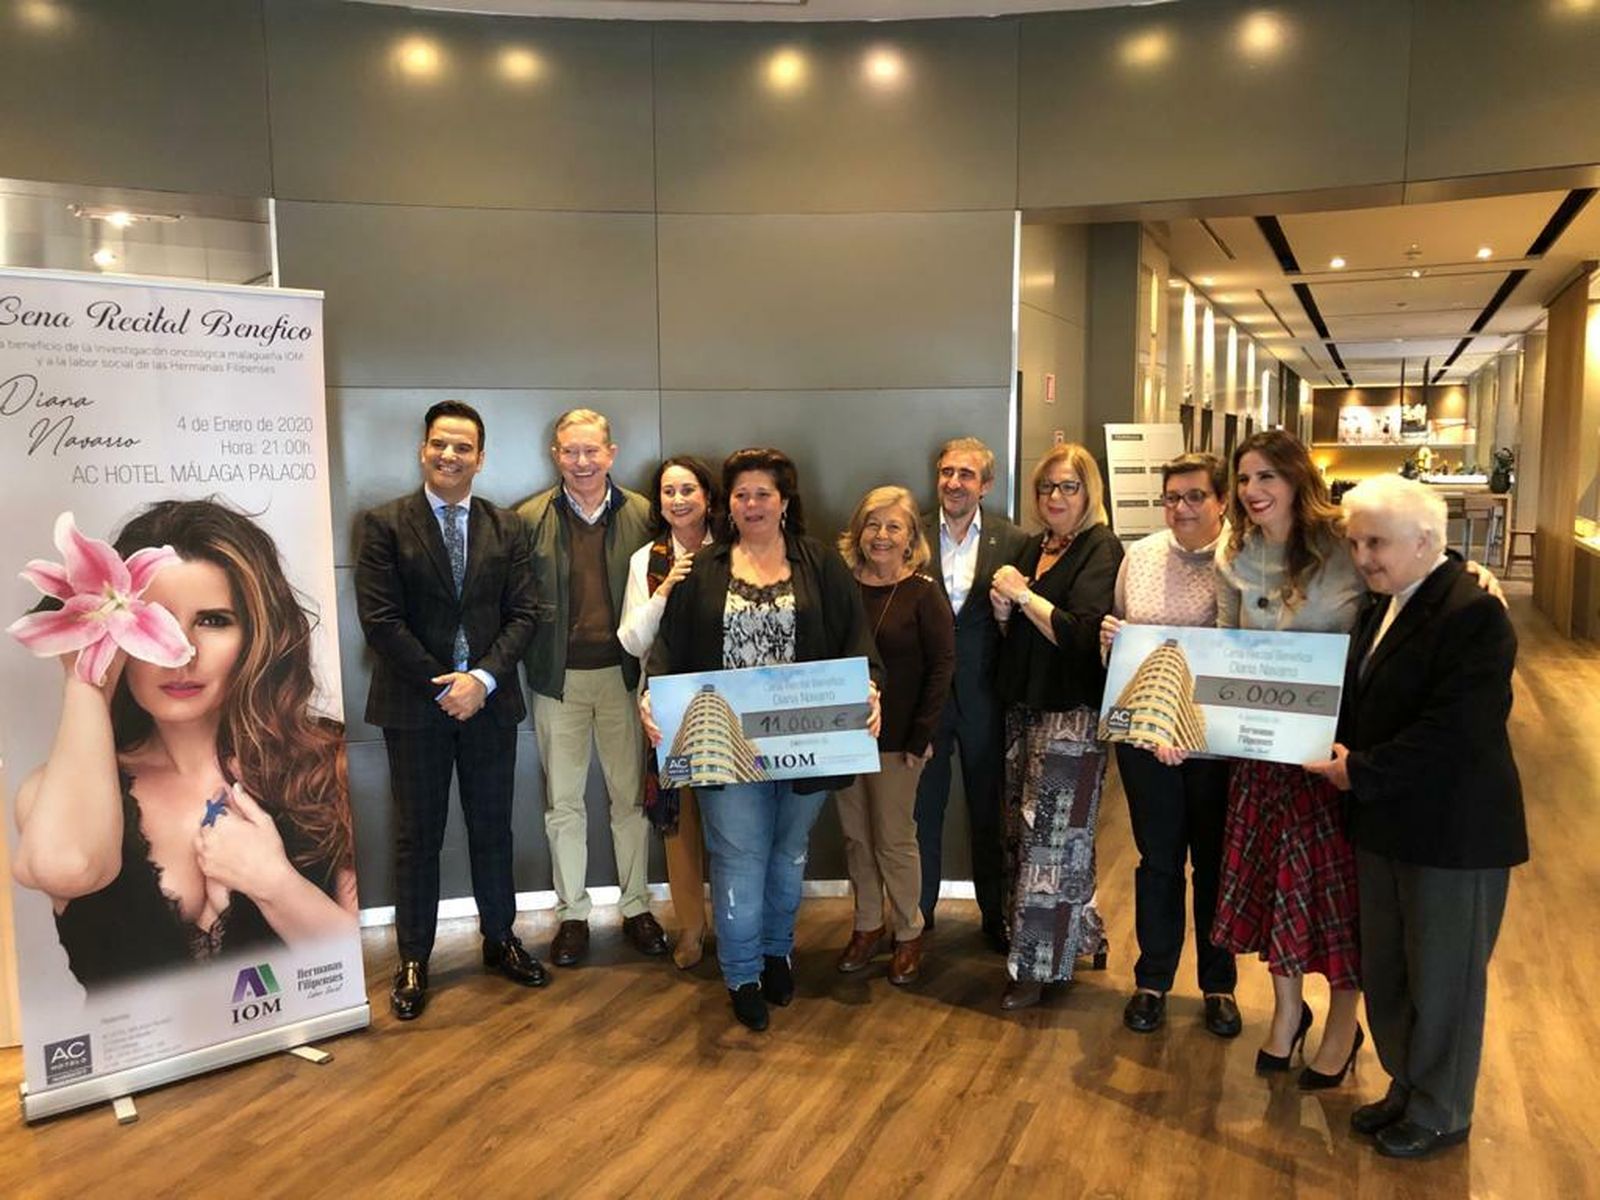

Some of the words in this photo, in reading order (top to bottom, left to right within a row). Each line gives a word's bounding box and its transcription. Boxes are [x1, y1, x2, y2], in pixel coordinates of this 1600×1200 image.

[87, 300, 191, 334] Recital
[200, 309, 312, 346] Benefico
[8, 339, 63, 352] beneficio
[65, 342, 79, 351] de
[81, 343, 92, 352] la
[56, 357, 67, 366] la
[69, 358, 98, 367] labor
[101, 358, 133, 369] social
[136, 360, 150, 370] de
[152, 360, 168, 370] las
[170, 361, 224, 373] Hermanas
[0, 374, 94, 416] Diana
[177, 416, 187, 430] 4
[192, 416, 209, 432] de
[214, 416, 252, 432] Enero
[257, 417, 273, 432] de
[278, 417, 314, 433] 2020
[28, 415, 140, 456] Navarro
[221, 439, 254, 456] Hora:
[72, 465, 98, 485] AC
[105, 465, 164, 484] HOTEL
[171, 460, 244, 481] MÁLAGA
[249, 463, 317, 481] PALACIO
[1218, 683, 1297, 706] 6.000
[1306, 689, 1326, 708] €
[1110, 710, 1130, 722] AC
[668, 758, 688, 769] AC
[774, 752, 817, 770] IOM
[231, 998, 282, 1024] IOM
[51, 1041, 87, 1064] AC
